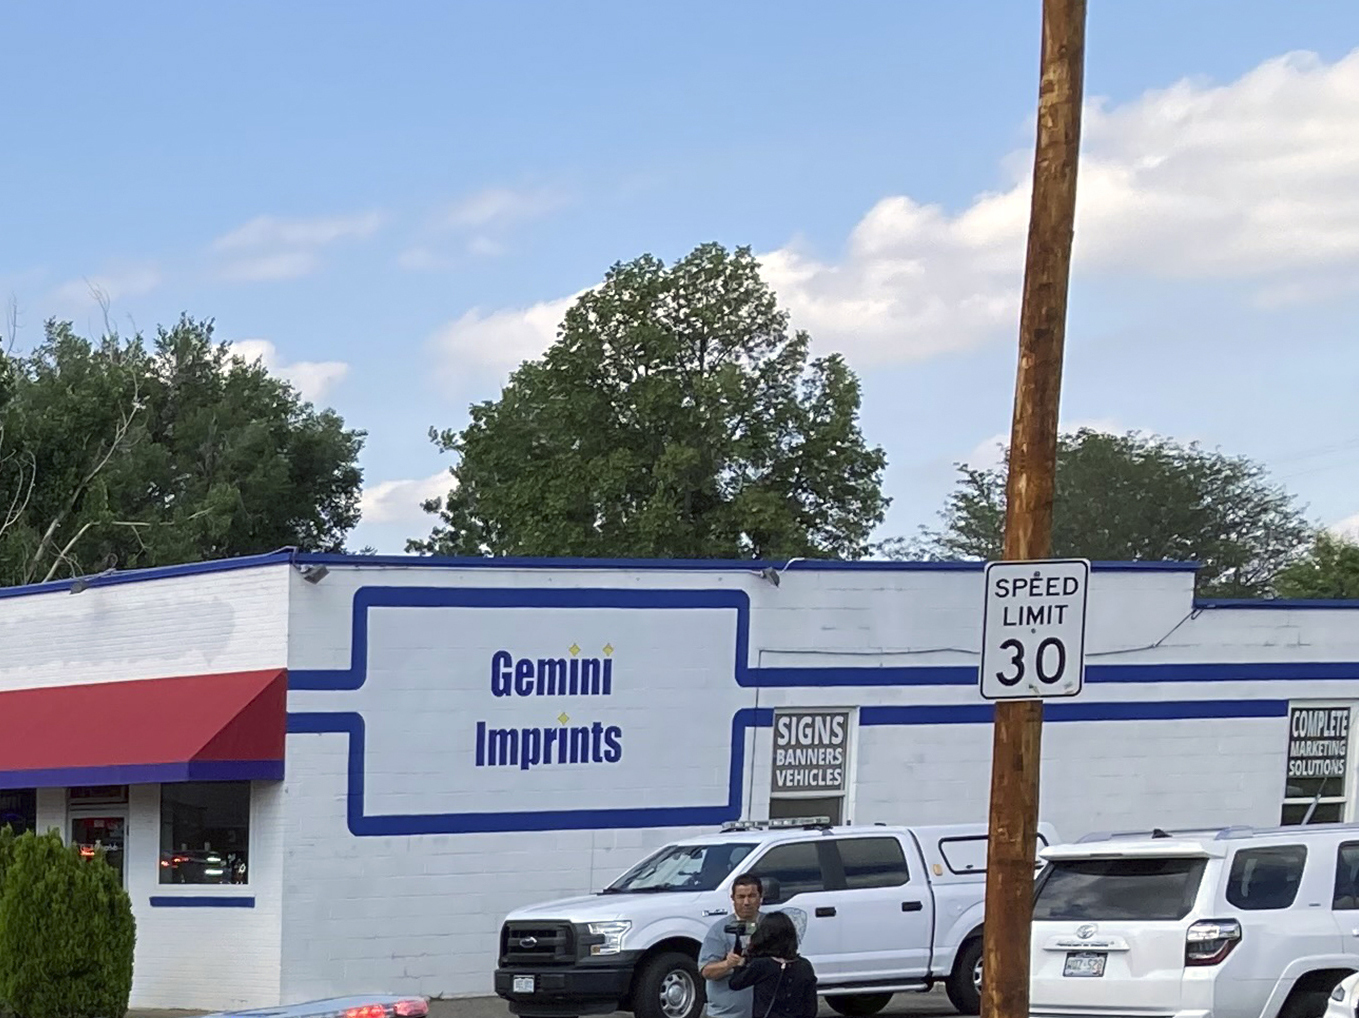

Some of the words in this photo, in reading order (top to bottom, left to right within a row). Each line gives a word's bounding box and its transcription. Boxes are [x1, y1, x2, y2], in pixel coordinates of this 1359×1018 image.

[995, 576, 1078, 598] SPEED
[1003, 604, 1068, 626] LIMIT
[491, 643, 614, 697] Gemini
[996, 637, 1066, 686] 30
[777, 715, 844, 746] SIGNS
[1292, 709, 1348, 737] COMPLETE
[475, 712, 623, 770] Imprints
[1290, 740, 1346, 757] MARKETING
[776, 747, 843, 766] BANNERS
[1288, 759, 1344, 776] SOLUTIONS
[775, 768, 842, 787] VEHICLES
